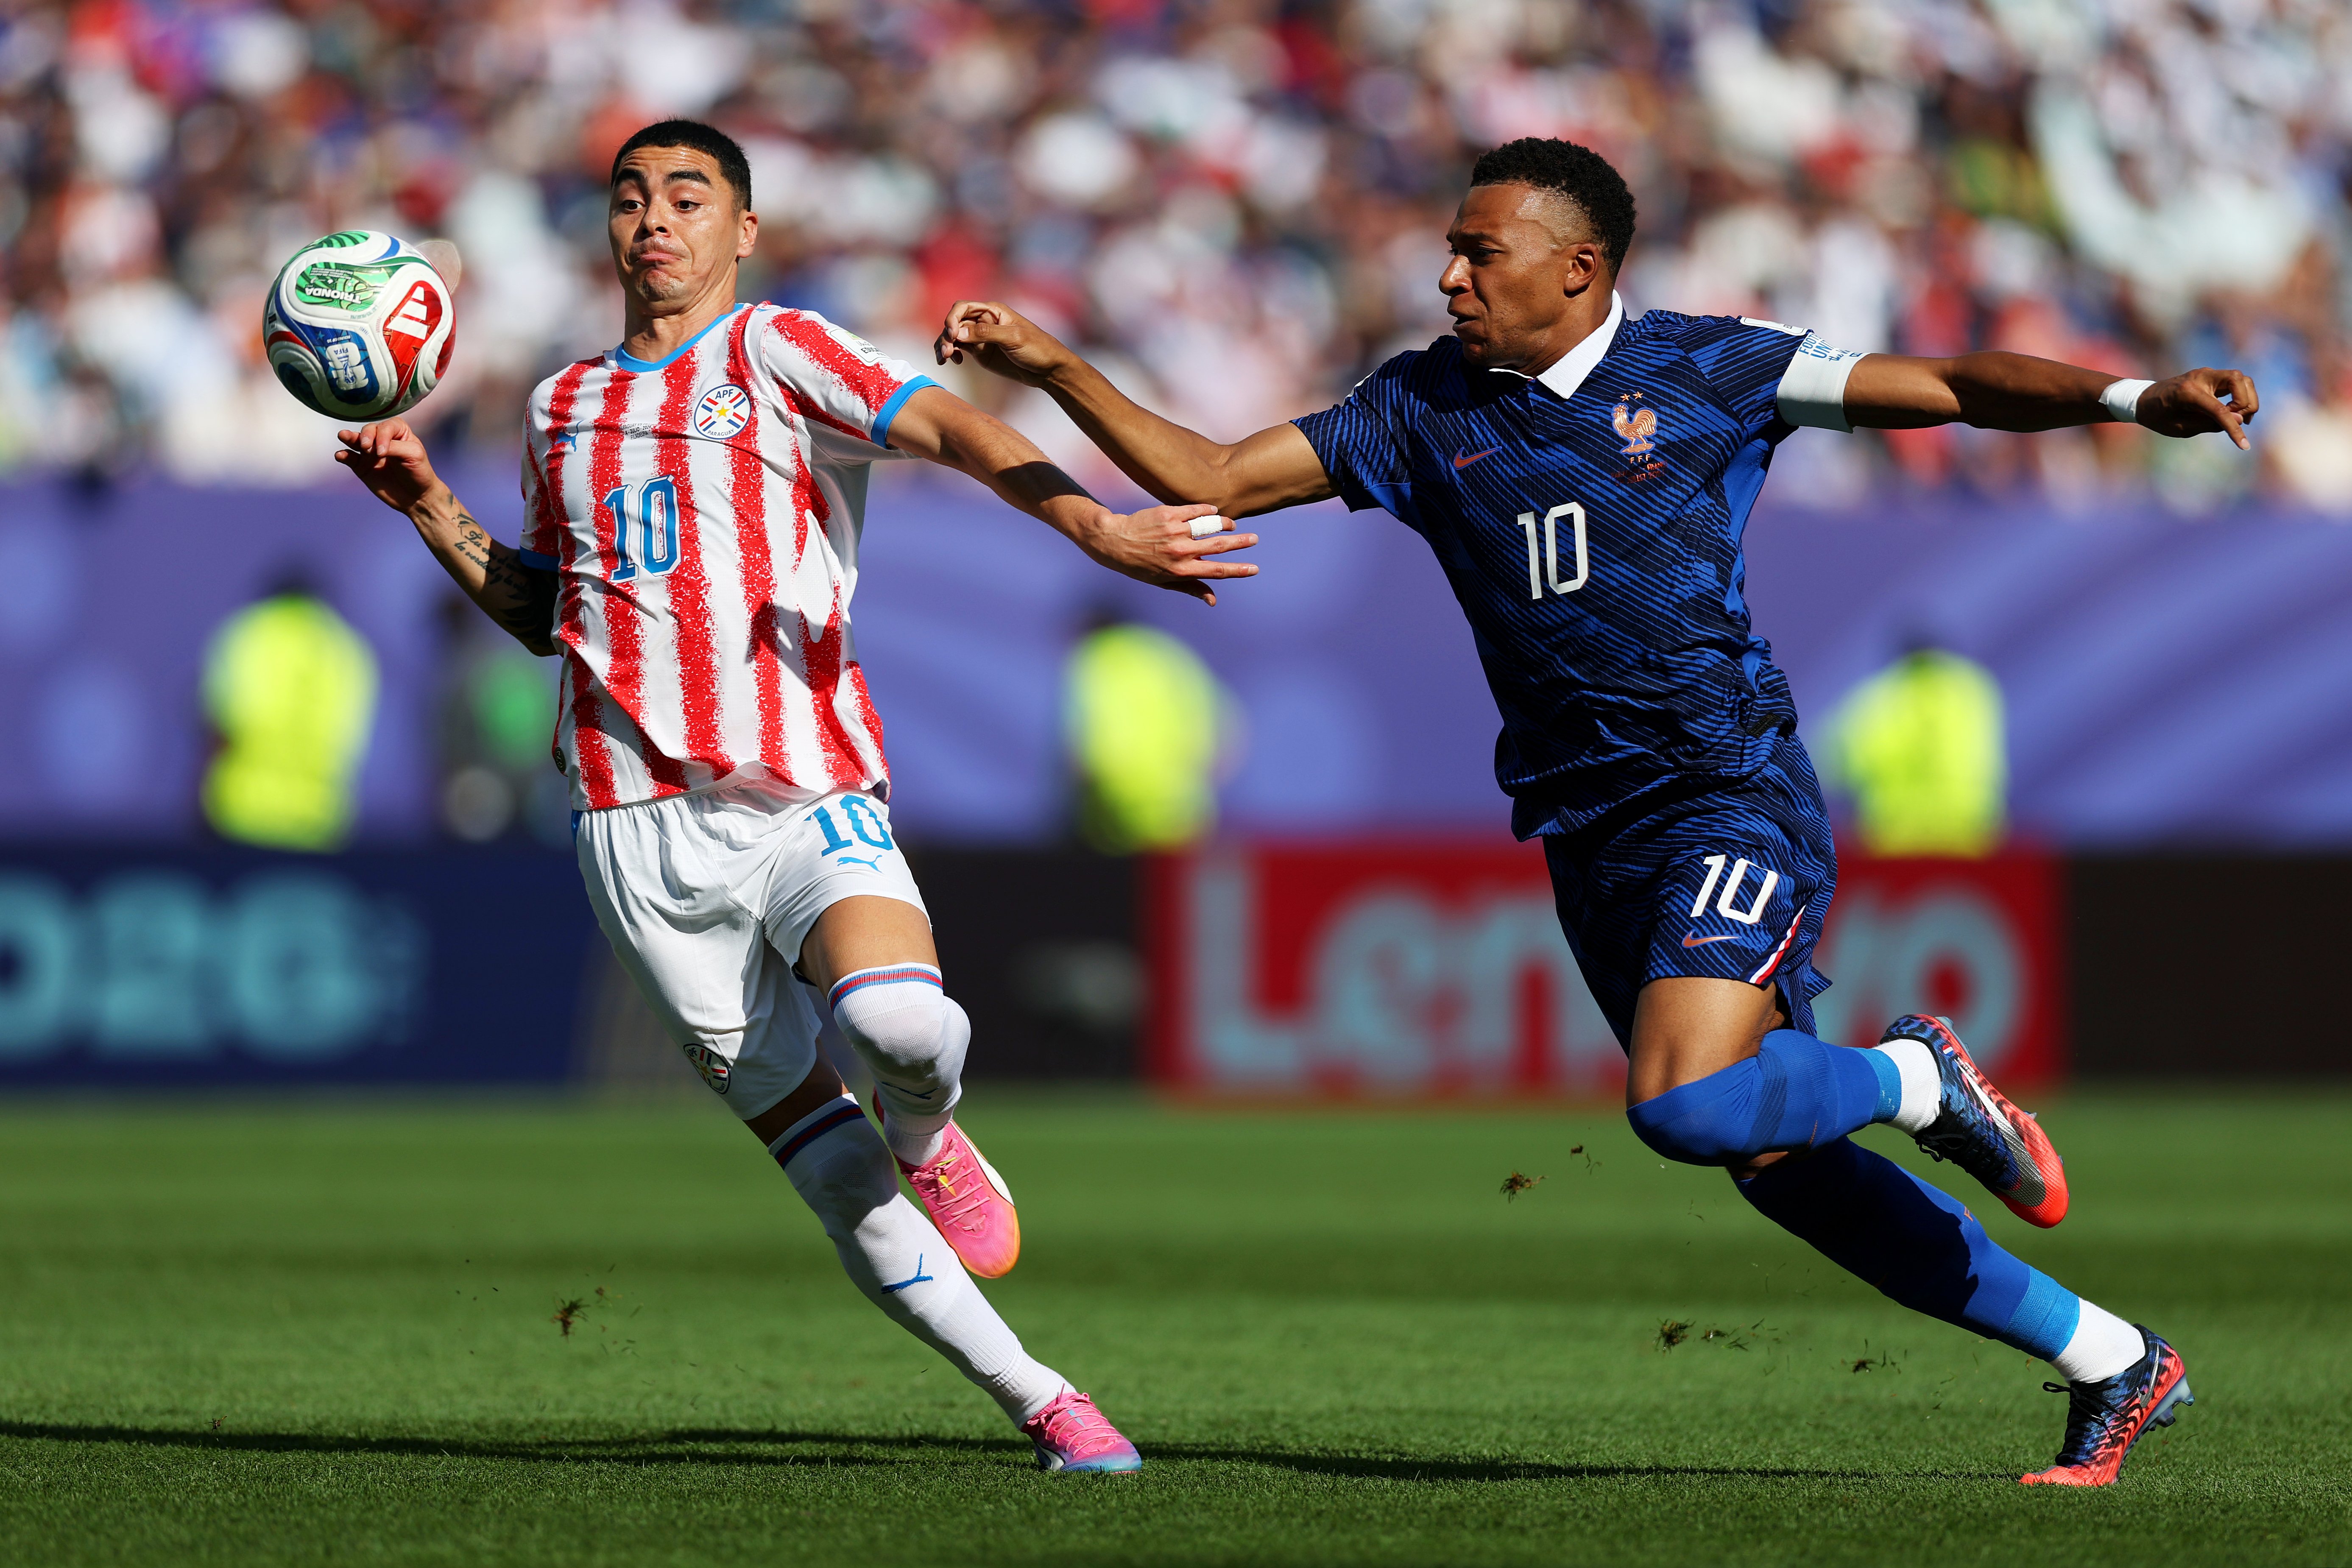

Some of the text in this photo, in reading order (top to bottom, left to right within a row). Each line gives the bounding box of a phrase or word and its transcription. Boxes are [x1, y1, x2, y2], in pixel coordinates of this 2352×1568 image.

[305, 287, 361, 304] TRIONDA
[715, 389, 734, 399] APF
[707, 428, 734, 437] PARAGUAY
[602, 474, 681, 583] 10
[1517, 502, 1589, 600] 10
[804, 795, 893, 857] 10
[1691, 854, 1779, 924] 10
